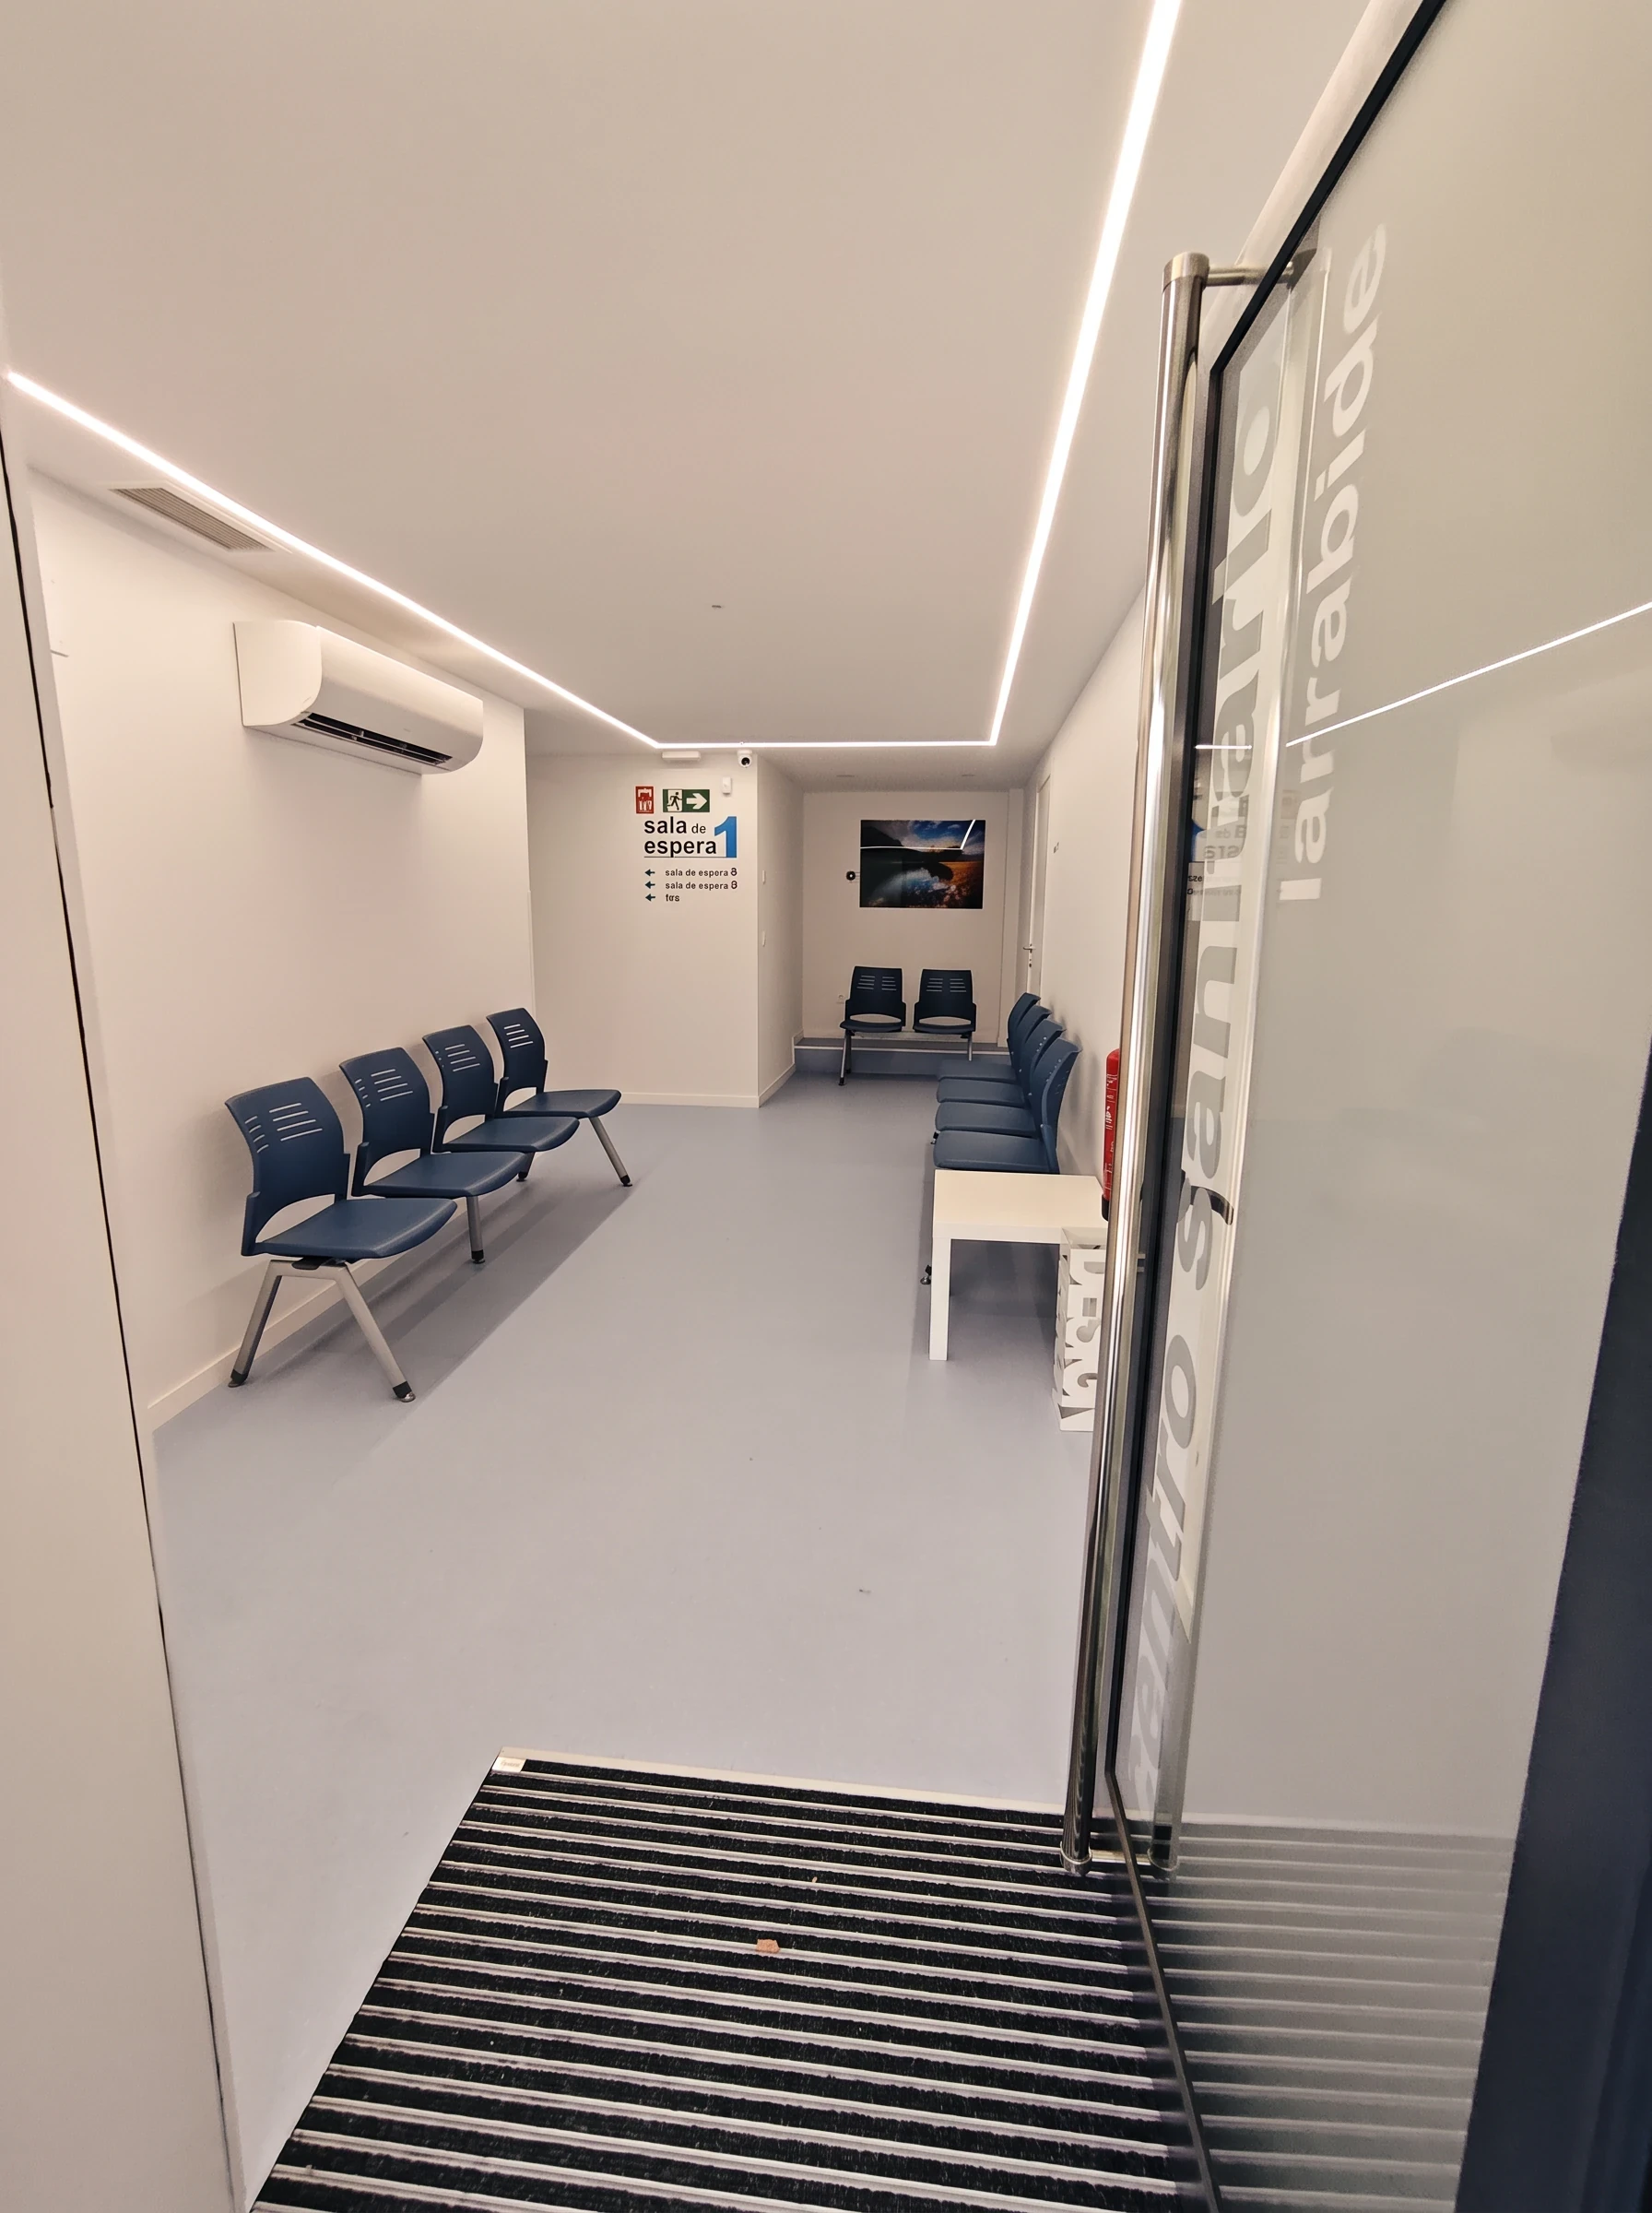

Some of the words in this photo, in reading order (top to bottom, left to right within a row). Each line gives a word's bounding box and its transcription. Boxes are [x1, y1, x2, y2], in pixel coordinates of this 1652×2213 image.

[1280, 221, 1386, 903] larrabide
[643, 816, 687, 834] sala
[691, 823, 706, 834] de
[643, 840, 716, 858] espera
[714, 816, 737, 858] 1
[665, 869, 683, 877] sala
[685, 869, 696, 877] de
[698, 870, 728, 878] espera
[665, 882, 683, 890] sala
[685, 882, 696, 890] de
[698, 882, 728, 891] espera
